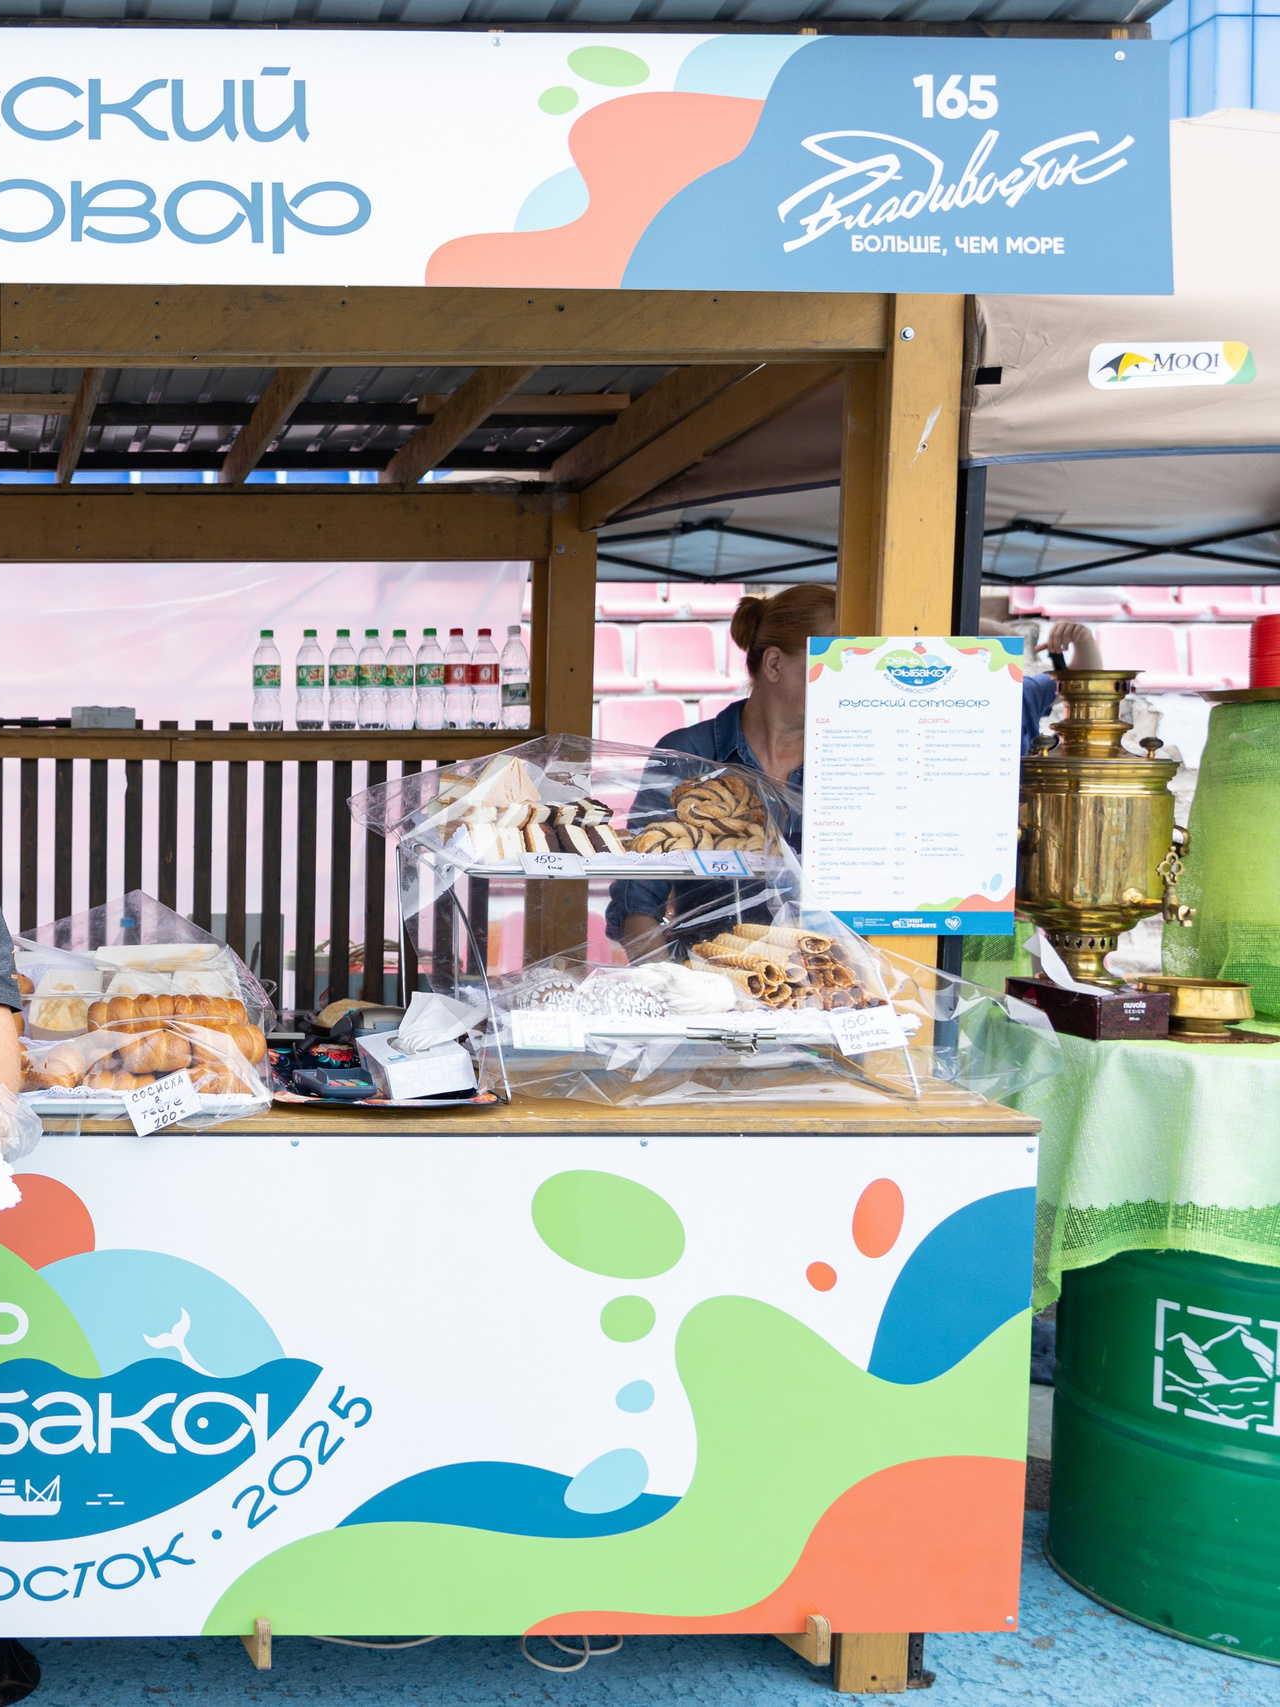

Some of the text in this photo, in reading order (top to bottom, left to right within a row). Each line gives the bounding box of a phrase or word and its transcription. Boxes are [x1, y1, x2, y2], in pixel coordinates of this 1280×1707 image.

[912, 73, 999, 120] 165
[776, 128, 1135, 253] Владивосток
[850, 234, 1065, 256] БОЛЬШЕ, ЧЕМ МОРЕ
[1151, 351, 1220, 374] MOQI
[1123, 1001, 1147, 1009] nuvola
[231, 1384, 373, 1531] 2025
